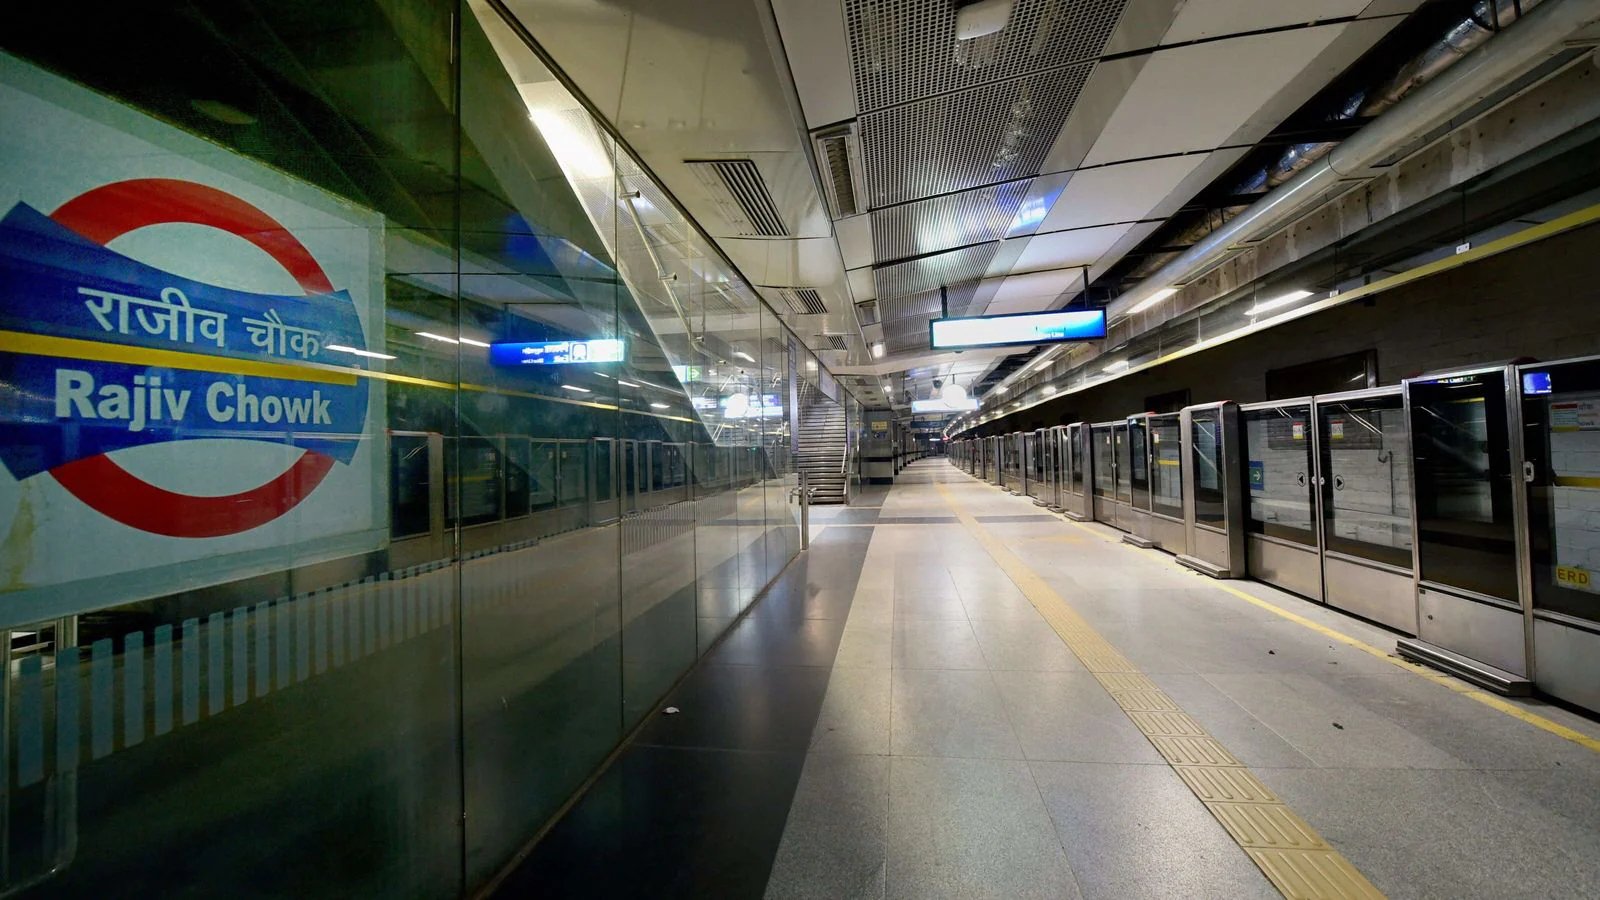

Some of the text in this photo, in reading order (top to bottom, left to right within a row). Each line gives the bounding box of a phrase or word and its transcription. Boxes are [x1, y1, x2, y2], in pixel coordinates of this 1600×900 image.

[77, 286, 321, 359] राजीव चौक
[55, 369, 332, 432] Rajiv Chowk
[1557, 567, 1588, 585] ERD
